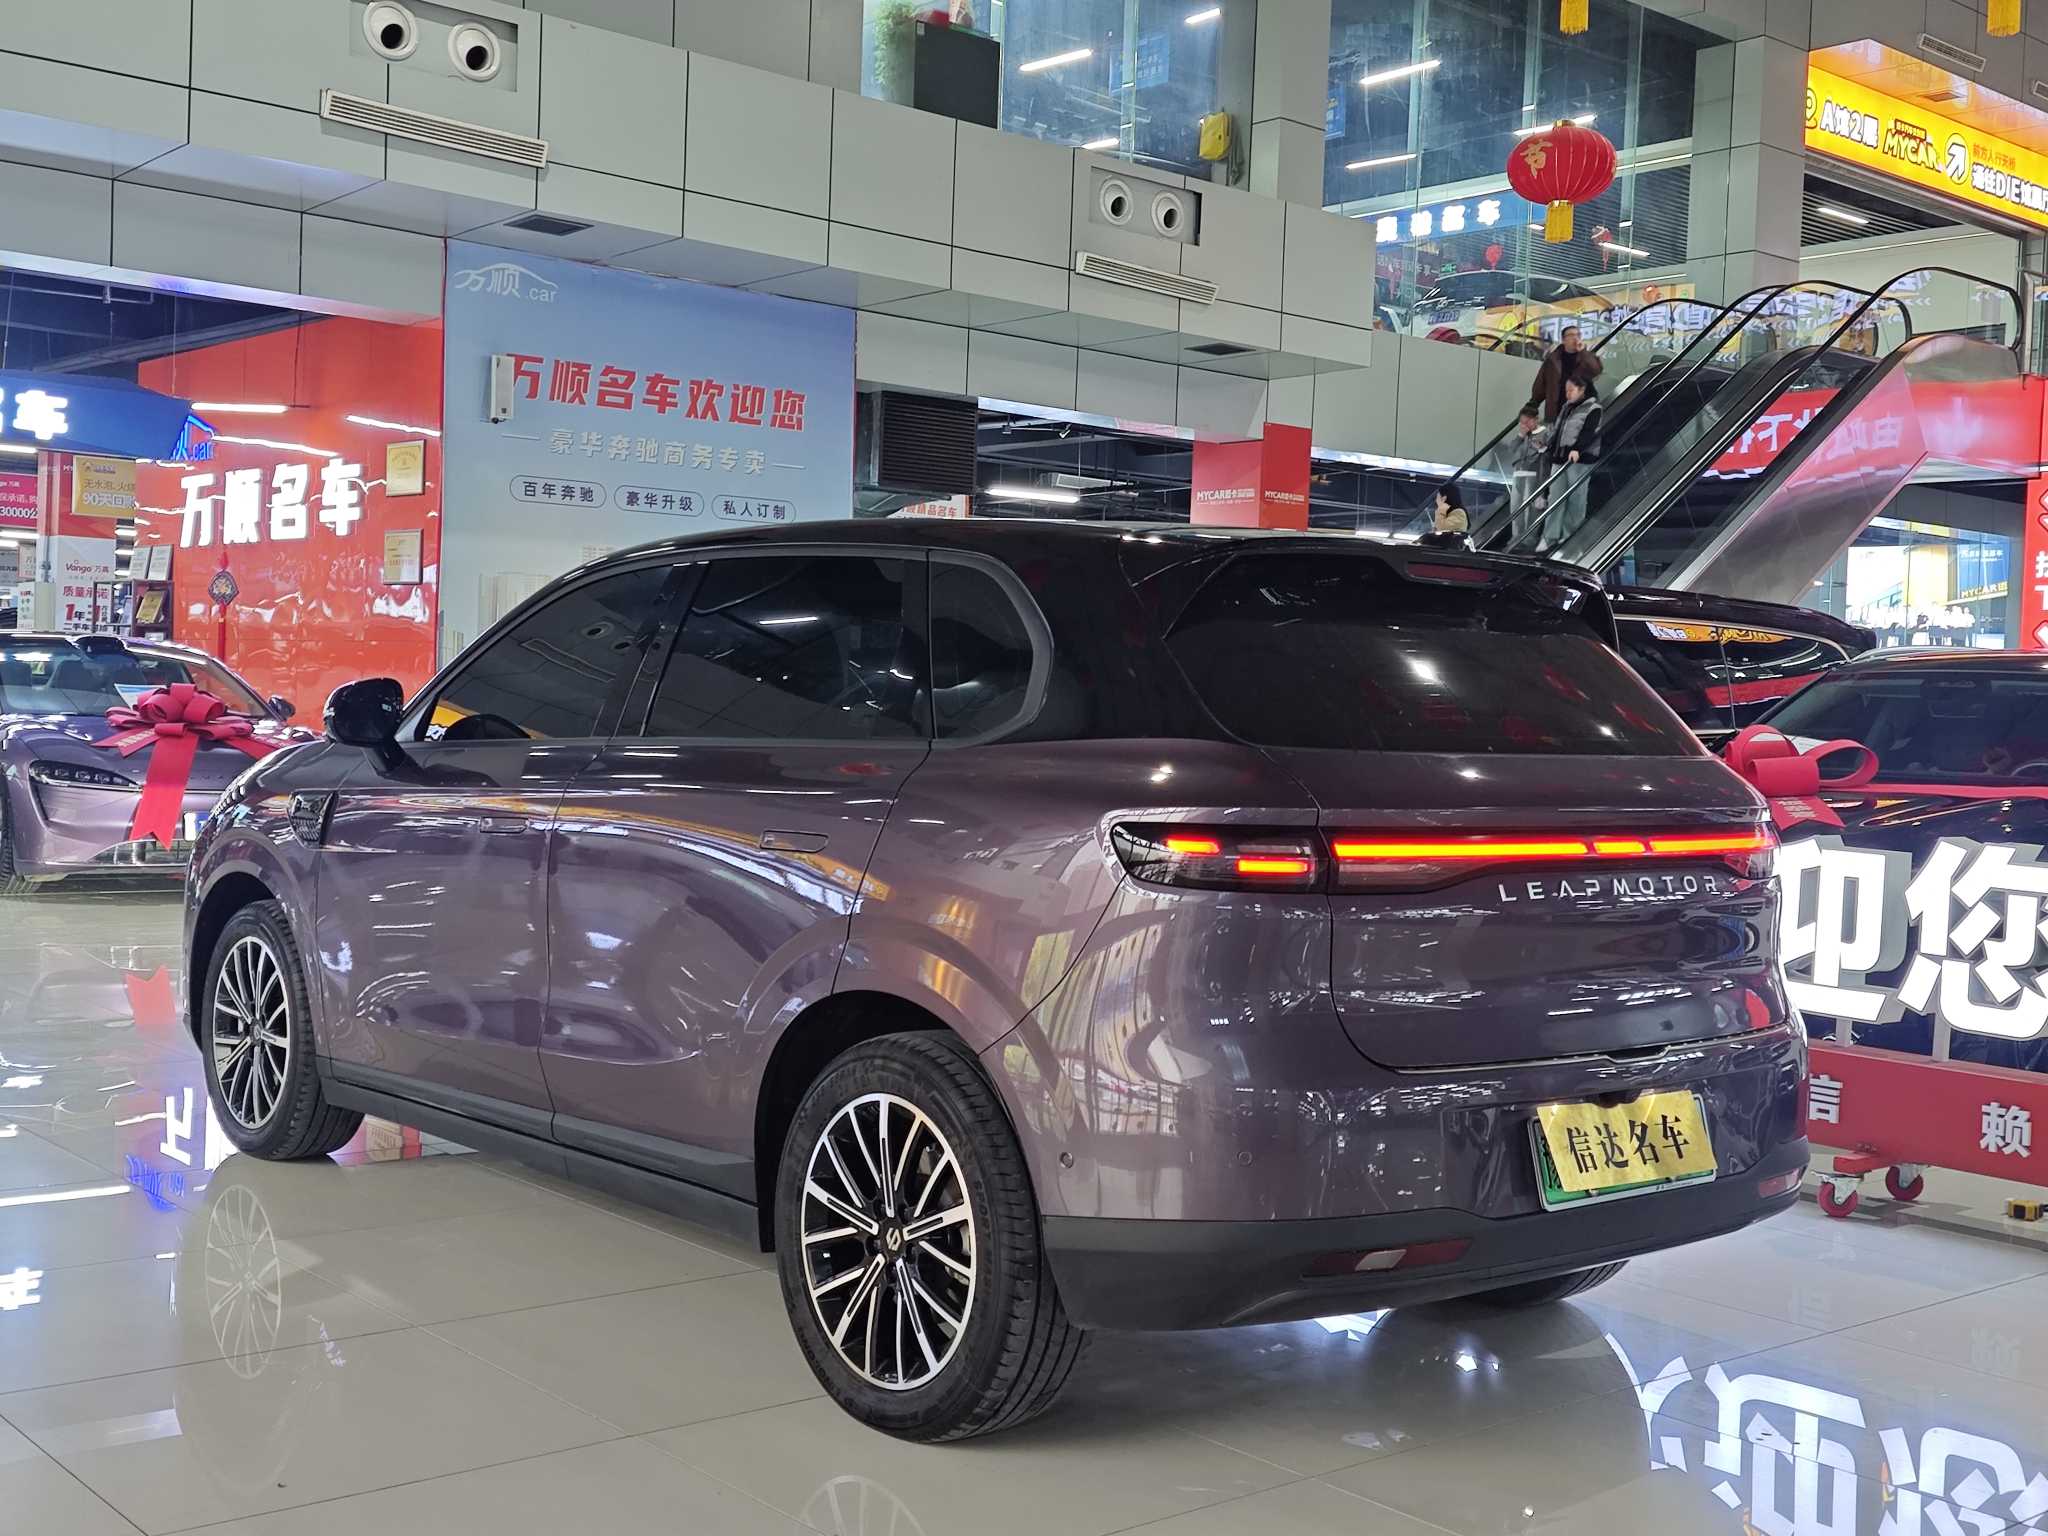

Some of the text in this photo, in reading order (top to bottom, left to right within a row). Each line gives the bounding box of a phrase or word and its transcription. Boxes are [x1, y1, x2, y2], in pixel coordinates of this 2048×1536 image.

[0, 388, 69, 441] 车
[506, 352, 808, 432] 万顺名车欢迎您
[550, 428, 768, 475] 豪华奔驰商务专卖
[180, 457, 361, 548] 万顺名车
[522, 479, 595, 504] 百年奔驰
[625, 490, 694, 514] 豪华升级
[723, 499, 786, 521] 私人订制
[1498, 874, 1718, 903] LEAPMOTOR
[1565, 1113, 1690, 1175] 信达名车
